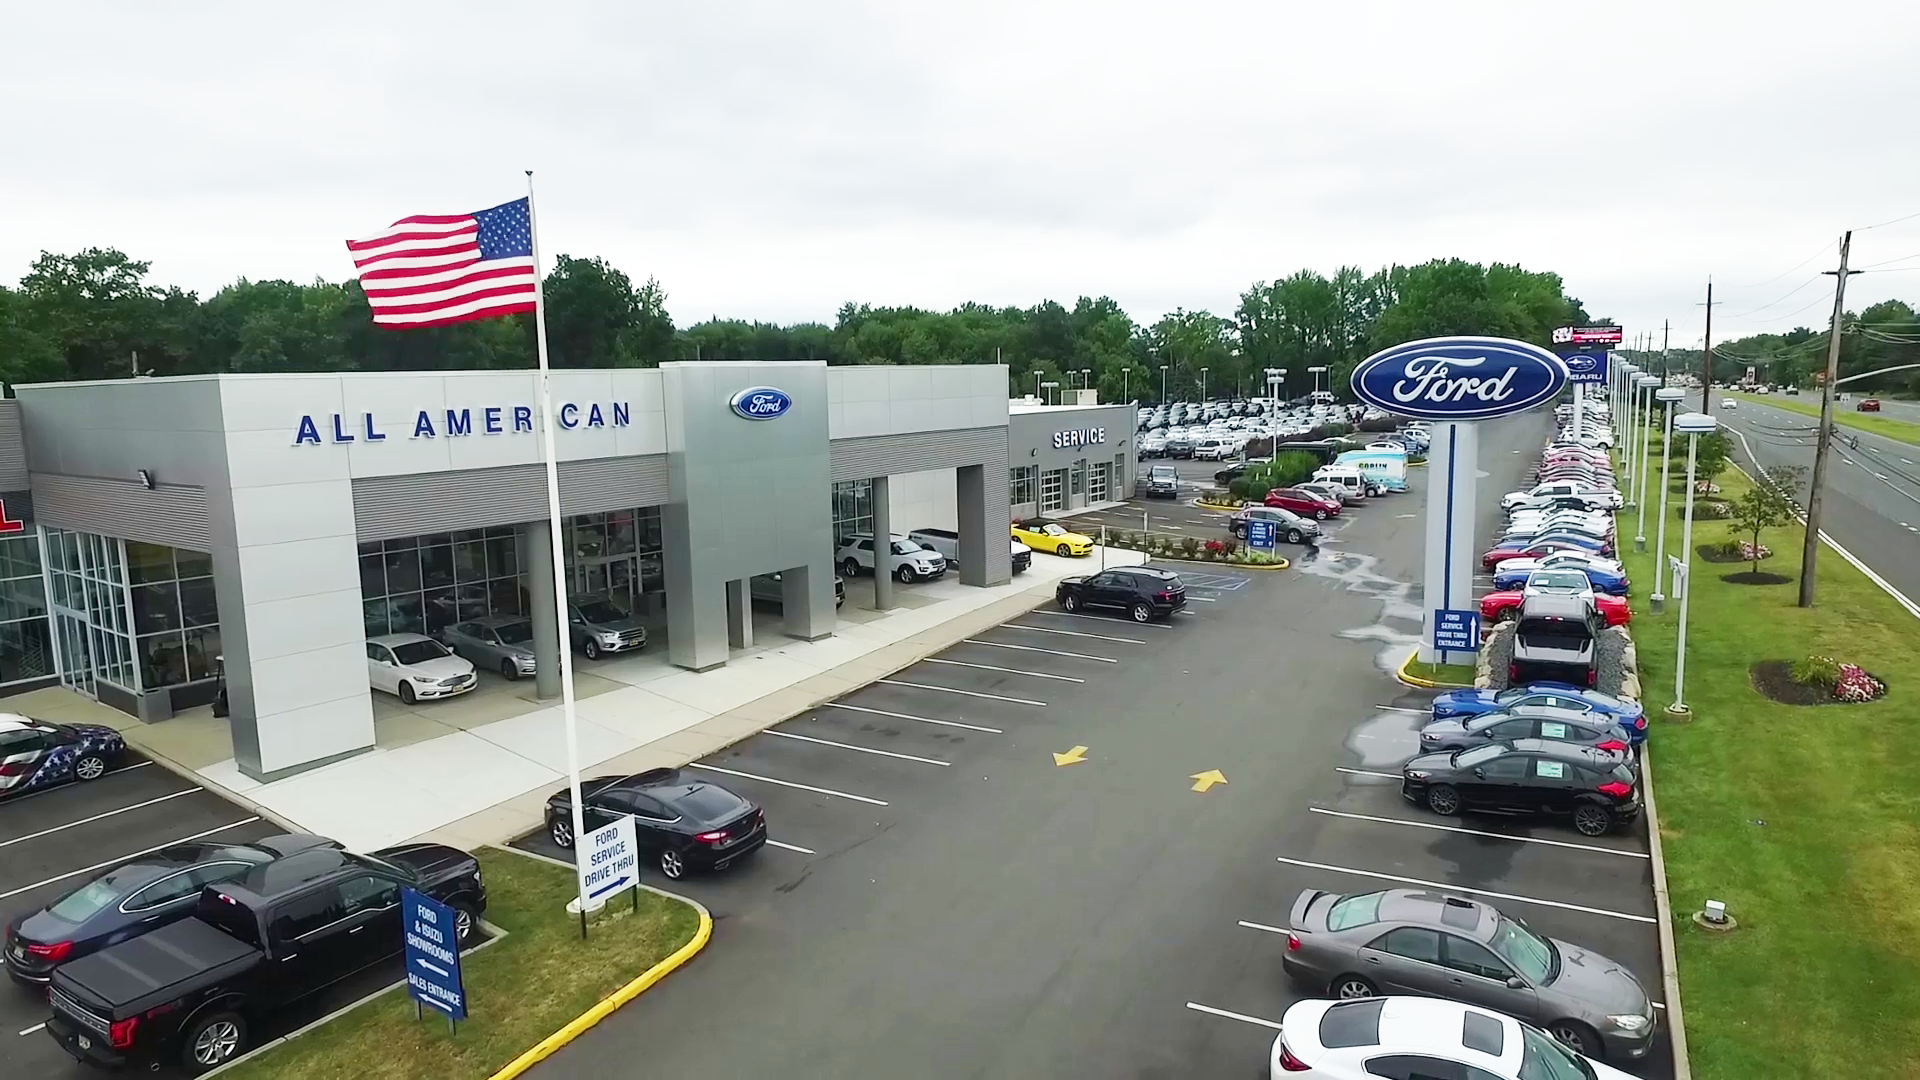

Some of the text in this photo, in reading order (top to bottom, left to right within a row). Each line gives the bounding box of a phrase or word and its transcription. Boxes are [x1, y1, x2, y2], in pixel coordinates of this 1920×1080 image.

[1393, 355, 1518, 403] Ford
[750, 394, 782, 413] Ford
[294, 402, 631, 445] ALL AMERCAN
[1053, 427, 1106, 449] SERVICE
[1440, 622, 1464, 630] SERVICE
[1444, 613, 1461, 621] FORD
[595, 827, 618, 847] FORD
[591, 840, 626, 867] SERVICE
[584, 854, 634, 888] DRIVE THRU
[417, 904, 437, 924] FORD
[414, 920, 444, 944] & ISUZU
[407, 932, 455, 965] SHOWROOMS
[408, 972, 461, 1007] SALES ENTRANCE
